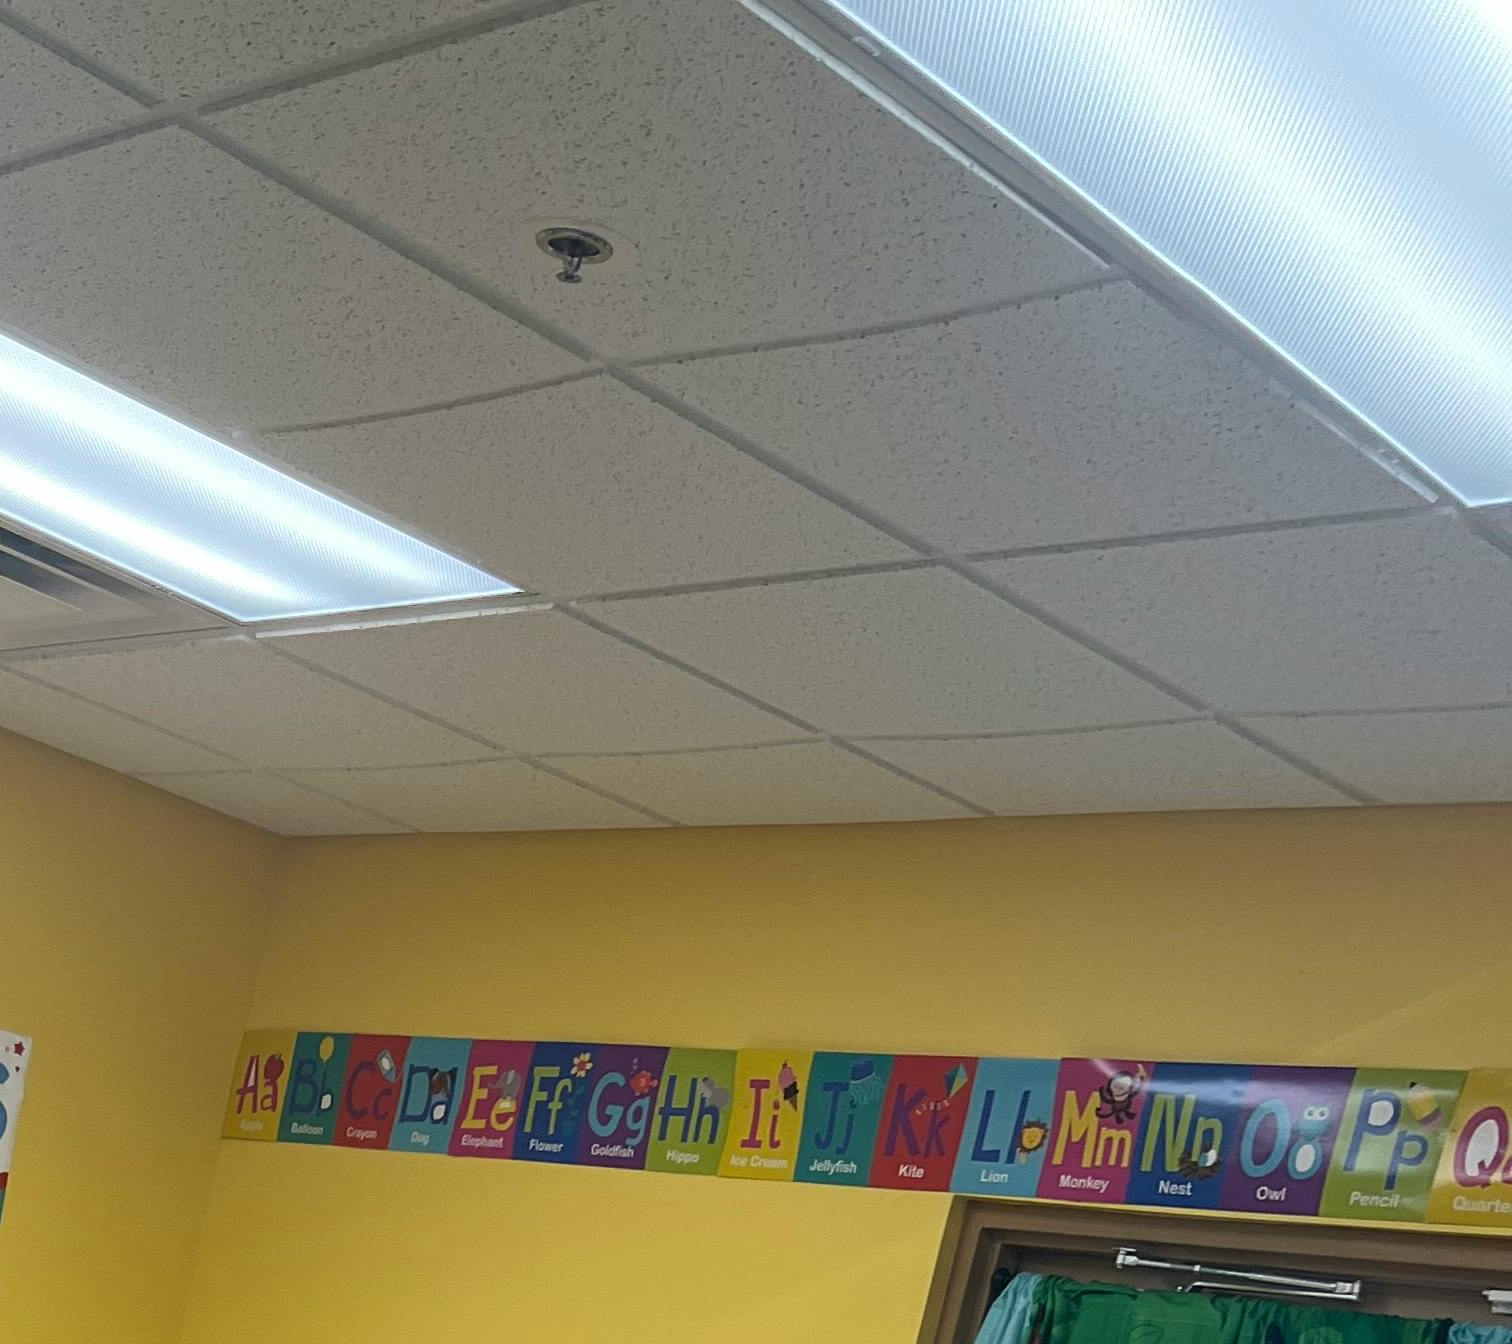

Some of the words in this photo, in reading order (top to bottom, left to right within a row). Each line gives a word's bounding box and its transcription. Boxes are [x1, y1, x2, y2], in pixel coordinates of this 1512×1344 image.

[346, 1060, 392, 1120] Cc
[460, 1065, 517, 1132] Ee
[523, 1066, 573, 1135] Ff
[588, 1072, 651, 1147] Gg
[658, 1075, 720, 1144] Hh
[740, 1079, 781, 1149] Ii
[814, 1082, 856, 1156] Jj
[884, 1083, 951, 1158] Kk
[291, 1122, 324, 1136] Balloon
[346, 1127, 377, 1140] Crayon
[1052, 1090, 1132, 1168] Mm
[1140, 1094, 1223, 1173] Nn
[410, 1131, 430, 1146] Dog
[461, 1135, 504, 1149] Elephant
[529, 1139, 564, 1153] Flower
[1344, 1088, 1429, 1191] Pp
[590, 1143, 634, 1158] Goldfish
[666, 1149, 700, 1164] Hippo
[730, 1154, 748, 1166] Ice
[749, 1155, 788, 1169] Cream
[809, 1158, 857, 1175] Jellyfish
[898, 1164, 924, 1179] Kite
[980, 1169, 1009, 1183] Lion
[1059, 1175, 1109, 1193] Monkey
[1158, 1181, 1192, 1196] Nest
[1255, 1186, 1287, 1201] Owl
[1350, 1192, 1400, 1209] Pencil
